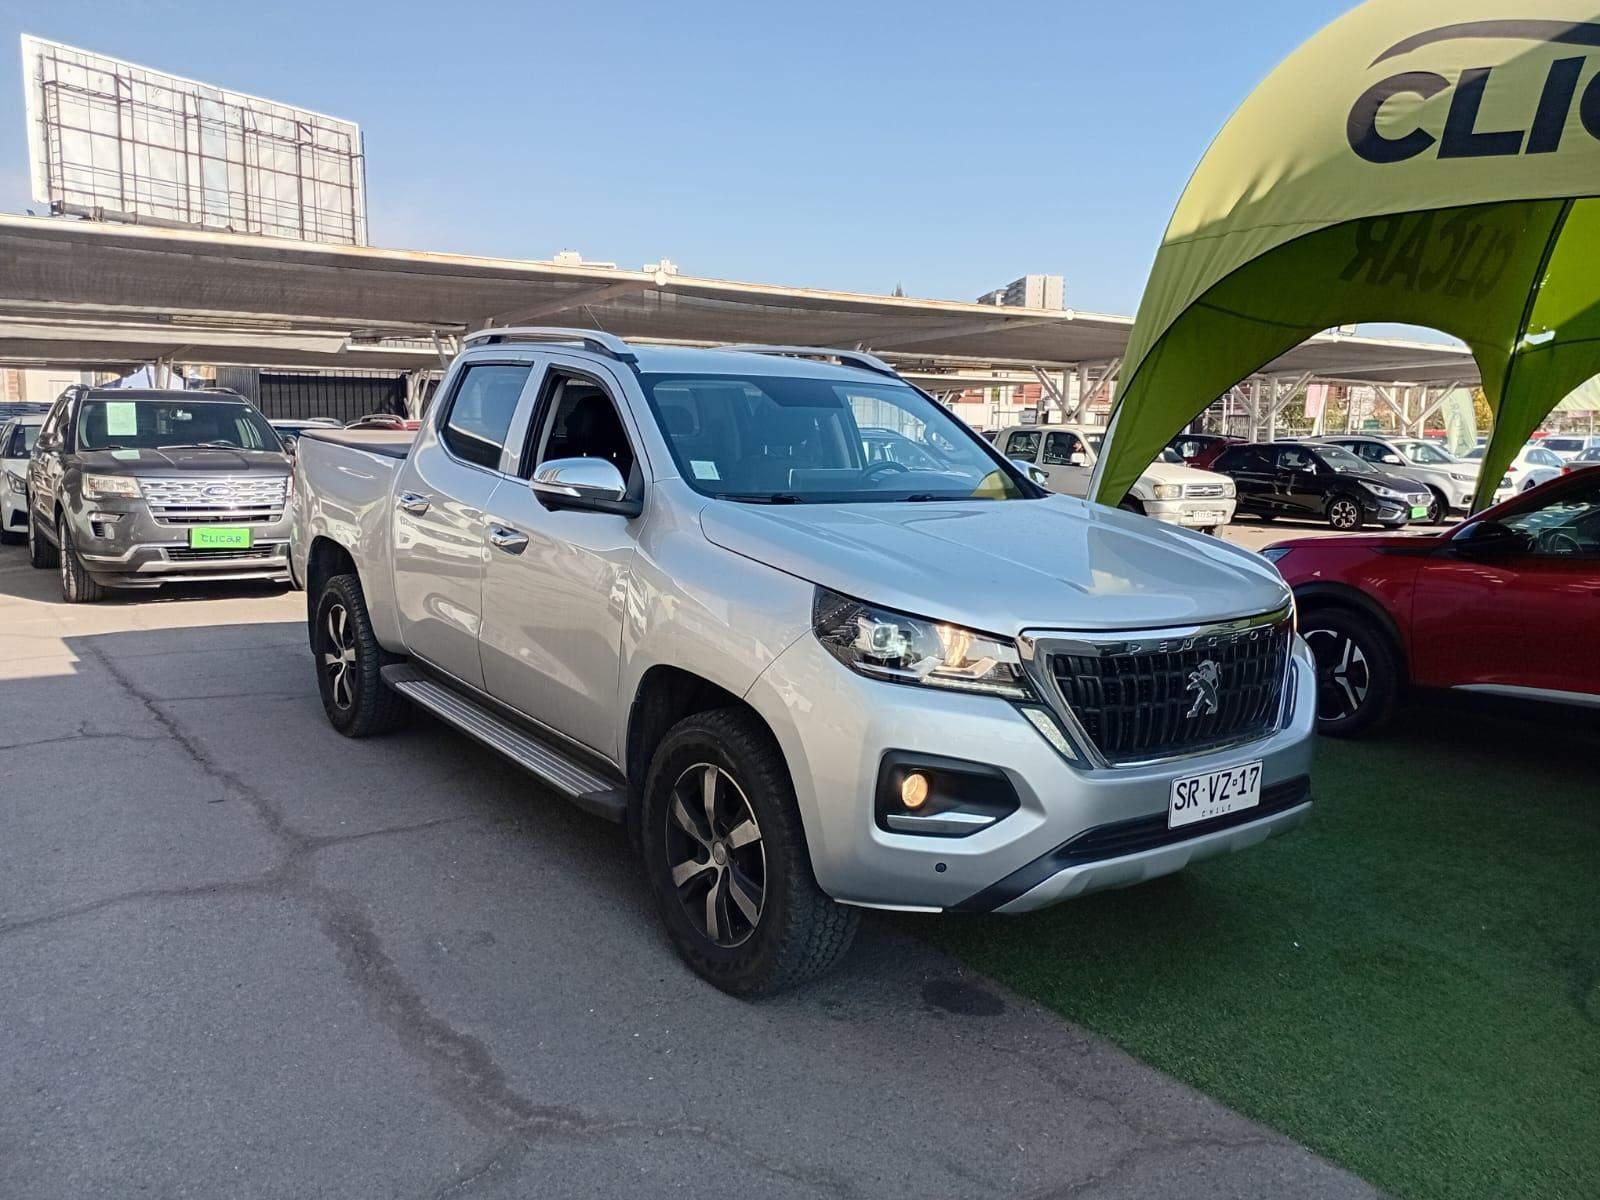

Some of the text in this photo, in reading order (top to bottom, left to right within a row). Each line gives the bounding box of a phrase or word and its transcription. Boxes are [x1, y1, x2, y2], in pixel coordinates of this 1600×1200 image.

[1346, 55, 1600, 164] CLI
[1129, 626, 1275, 655] PEUGEOT
[1201, 804, 1231, 817] CHILE
